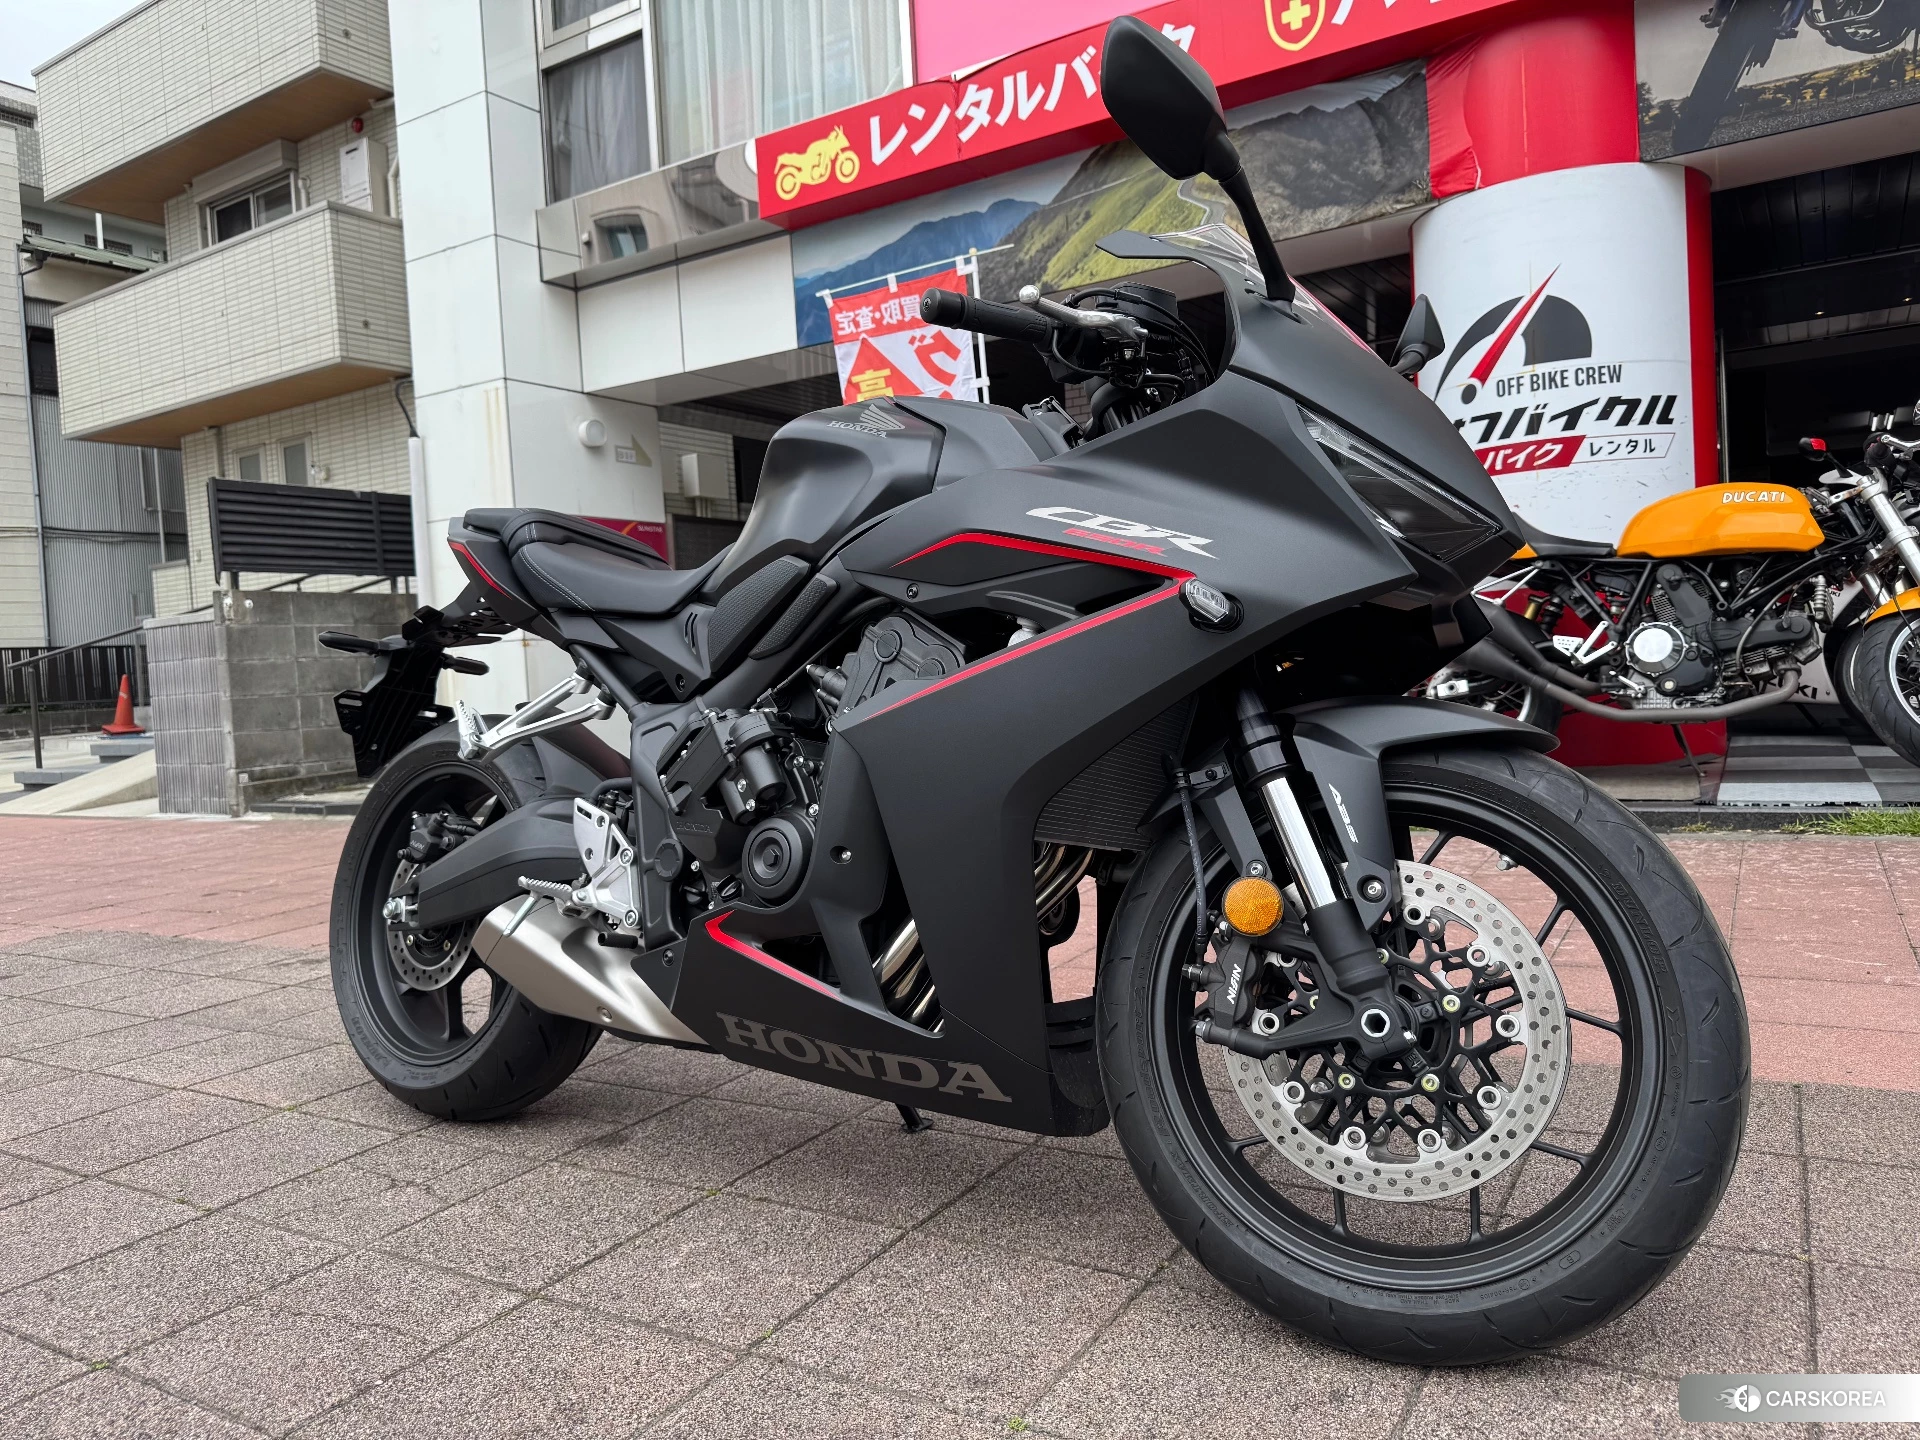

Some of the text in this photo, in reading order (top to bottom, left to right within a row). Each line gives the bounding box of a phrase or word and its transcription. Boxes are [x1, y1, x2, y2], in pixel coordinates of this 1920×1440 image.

[1496, 364, 1623, 398] OFF BIKE CREW
[827, 420, 887, 439] HONDA
[1589, 438, 1656, 457] レンタル
[1722, 491, 1785, 504] DUCATI
[1025, 506, 1220, 560] CBR
[1063, 528, 1168, 557] 650R
[1328, 783, 1359, 844] ABS
[716, 1011, 1013, 1103] HONDA
